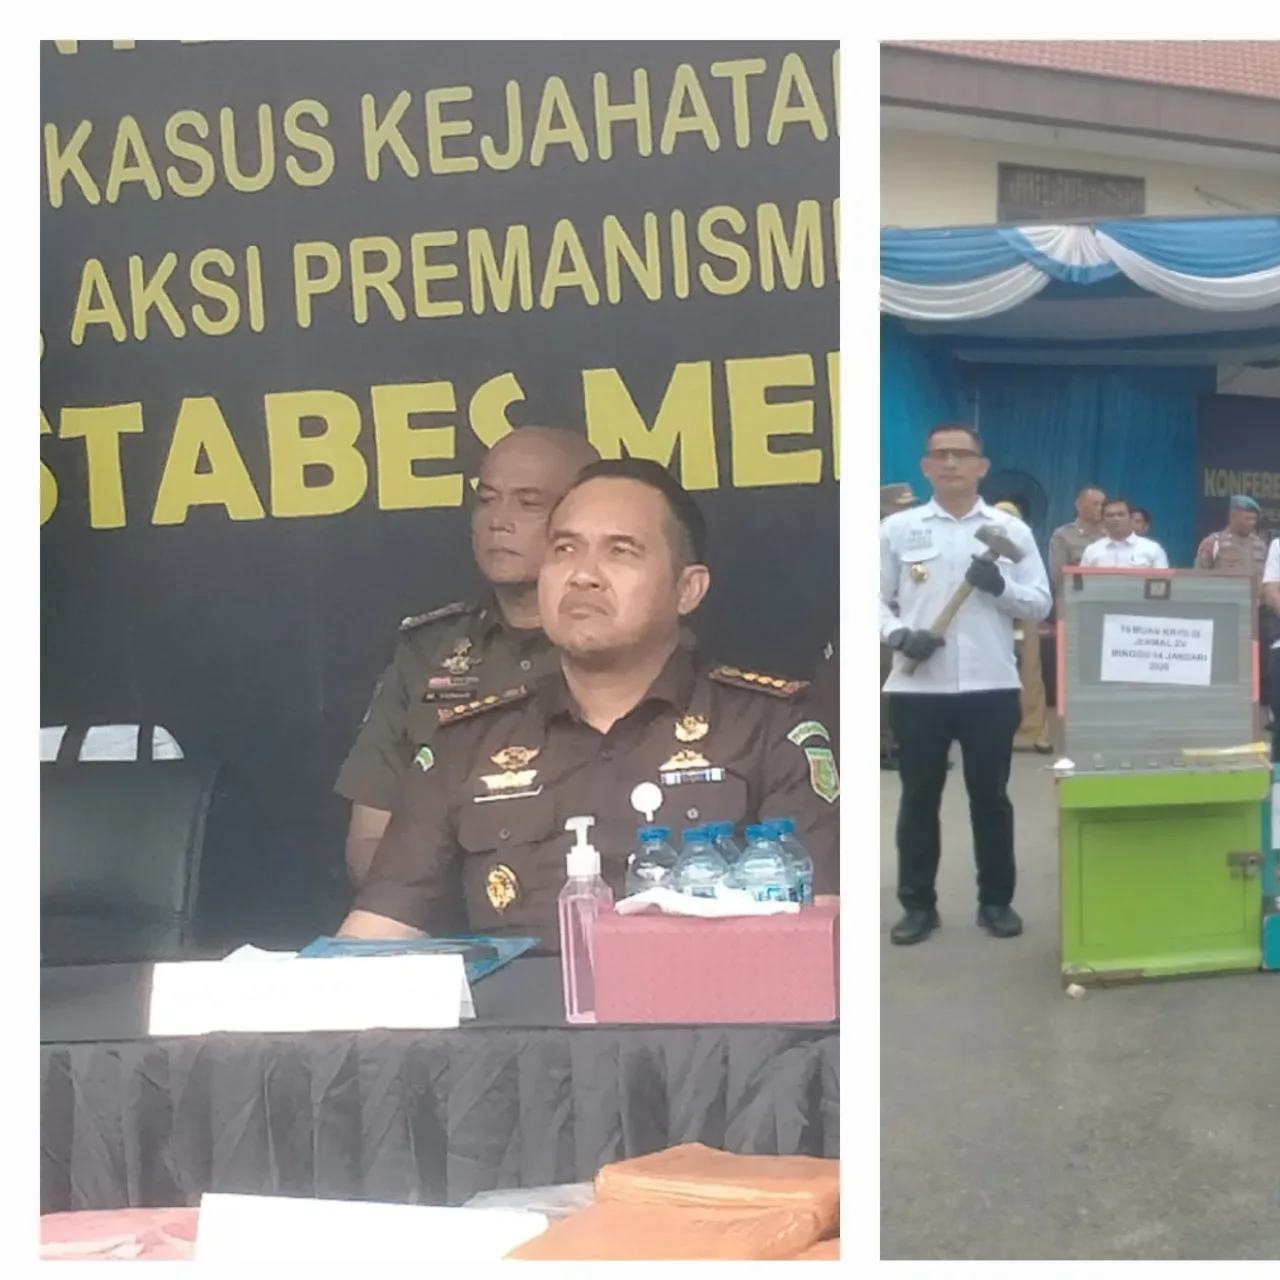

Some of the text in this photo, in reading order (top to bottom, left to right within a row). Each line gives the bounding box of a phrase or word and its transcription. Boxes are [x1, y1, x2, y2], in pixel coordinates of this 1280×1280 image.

[44, 51, 840, 208] KASUS KEJAHATA
[71, 245, 265, 346] AKSI
[582, 354, 840, 492] ME
